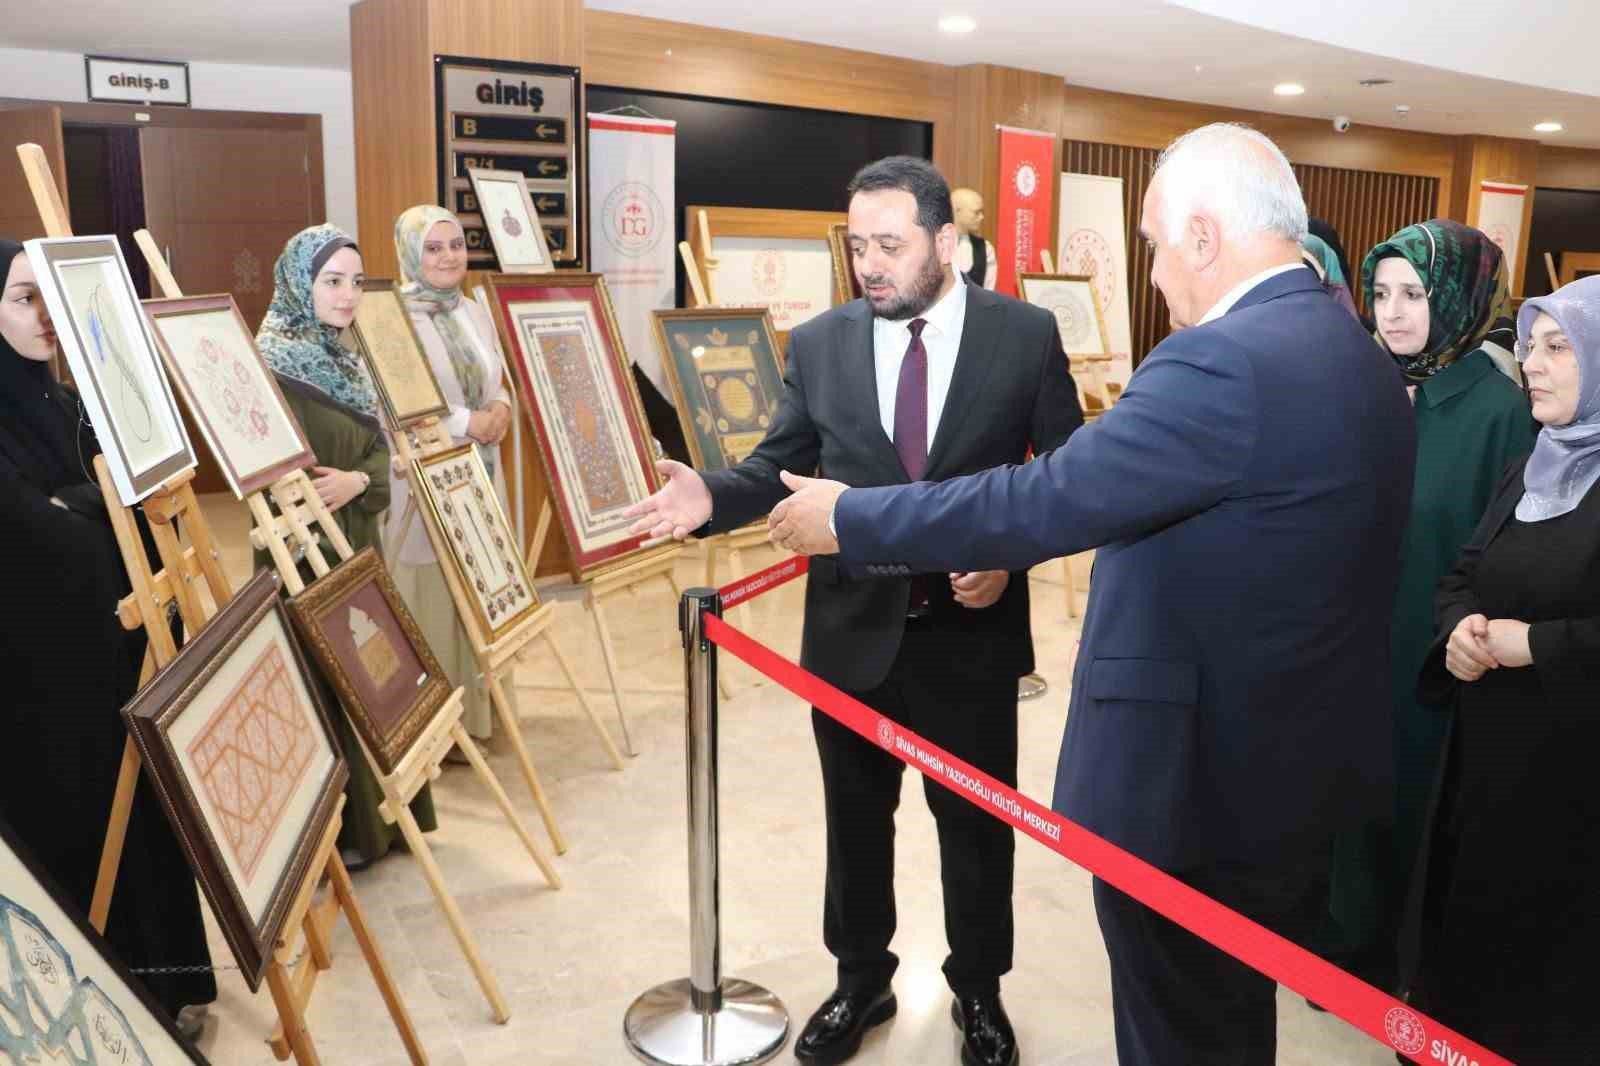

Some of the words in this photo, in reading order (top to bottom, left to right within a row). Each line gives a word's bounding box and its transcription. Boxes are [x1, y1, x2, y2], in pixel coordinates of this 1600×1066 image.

[108, 72, 169, 92] GİRİŞ-B
[476, 79, 544, 112] GİRİŞ
[463, 118, 477, 135] B
[896, 735, 916, 758] SİVAS
[916, 747, 944, 776] MUHSİN
[944, 763, 991, 801] YAZICIOĞLU
[991, 791, 1022, 821] KÜLTÜR
[1023, 809, 1061, 842] MERKEZİ
[1430, 1039, 1480, 1066] SİVA
